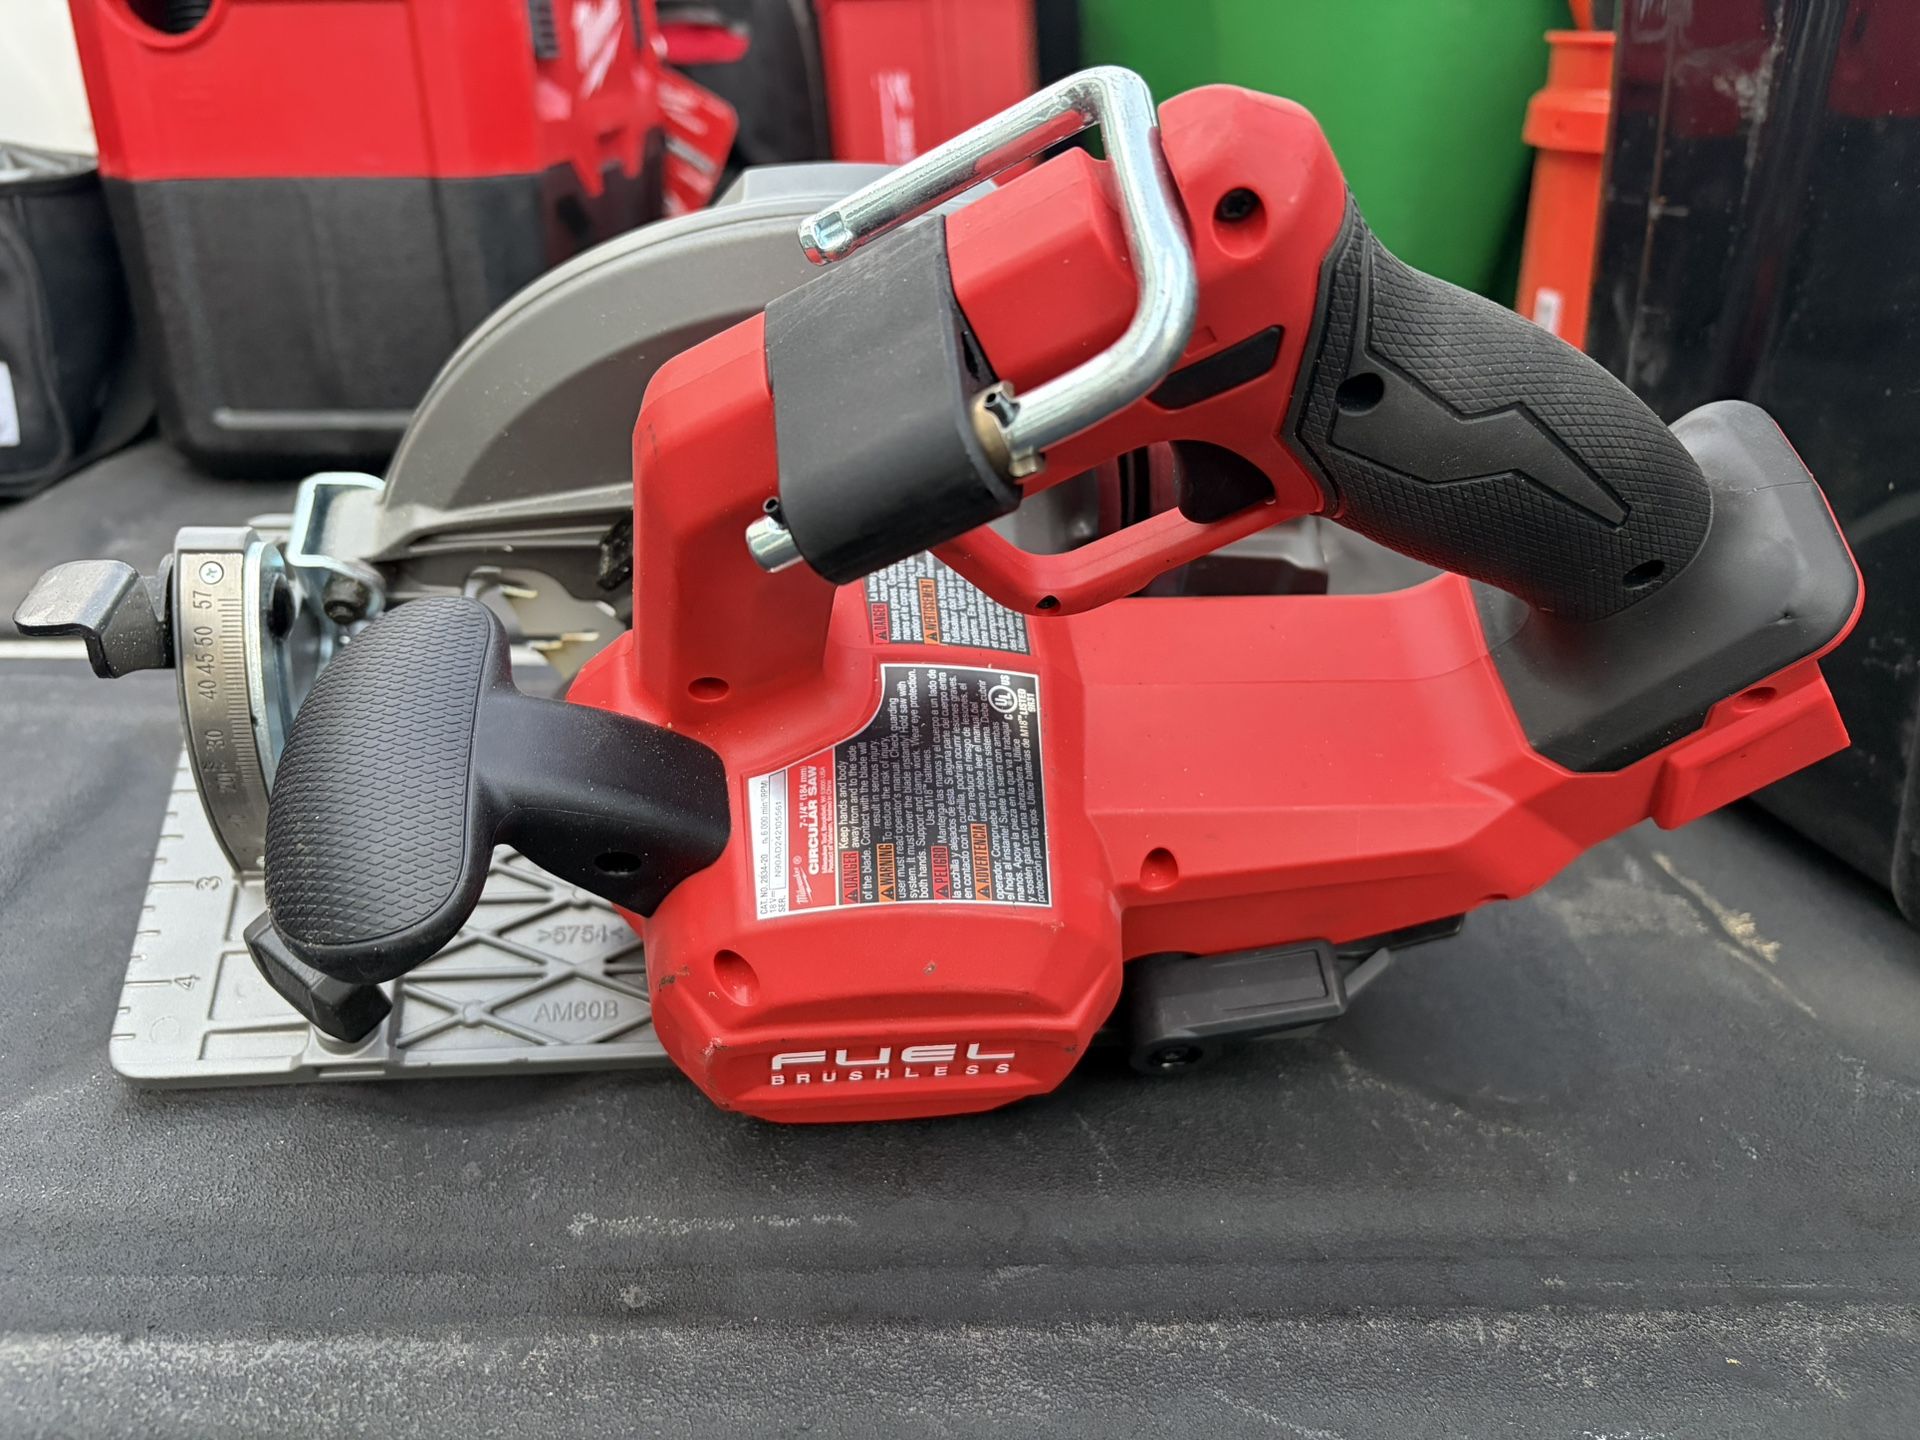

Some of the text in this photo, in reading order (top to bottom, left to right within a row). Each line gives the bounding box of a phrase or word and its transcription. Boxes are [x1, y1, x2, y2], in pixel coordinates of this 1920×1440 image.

[192, 590, 213, 610] 57
[921, 580, 936, 631] AVERTISSEMENT
[873, 605, 886, 630] DANGER
[193, 625, 214, 647] 50
[194, 653, 216, 675] 45
[197, 679, 219, 700] 40
[897, 681, 906, 696] with
[949, 676, 960, 702] graves.
[978, 680, 988, 701] cubrir
[900, 698, 908, 714] saw
[980, 703, 989, 723] Debe
[1017, 688, 1029, 715] LISTED
[888, 698, 900, 730] guarding
[899, 715, 908, 733] Hold
[951, 703, 960, 733] lesiones
[889, 733, 899, 757] Check
[992, 721, 1001, 747] ambas
[963, 738, 974, 762] riesgo
[974, 754, 983, 768] leer
[995, 748, 1003, 763] con
[869, 739, 881, 826] result serious injury.
[881, 771, 889, 785] risk
[902, 772, 912, 793] blade
[908, 669, 929, 898] both hands. Support and clamp Wear eye protection.
[928, 680, 948, 883] PELIGRO Mantenga las manos cuerpo lado
[939, 672, 961, 889] cuchilla alejados Si alguna parte del cuerpo entra
[964, 774, 976, 800] reducir
[976, 771, 985, 790] debe
[995, 764, 1005, 787] sierra
[848, 745, 861, 848] away from and the side
[881, 786, 890, 799] the
[903, 796, 912, 808] the
[858, 742, 871, 889] the blade. Contact with the blade will
[881, 802, 891, 829] reduce
[893, 793, 905, 834] operator's
[925, 809, 935, 826] Use
[967, 803, 977, 821] Para
[978, 793, 987, 821] usuario
[998, 798, 1009, 823] Sujete
[1002, 721, 1025, 901] manos. Apoye pieza que trabajar
[1013, 739, 1035, 894] sostén con una abrazadera. Utilice
[807, 766, 819, 875] CIRCULAR SAW
[837, 760, 858, 888] DANGER Keep hands and body
[882, 832, 892, 841] To
[895, 836, 904, 854] read
[906, 834, 915, 855] must
[961, 834, 969, 849] con
[989, 810, 1001, 857] Compruebe
[1025, 782, 1046, 902] protección para los Utilice
[879, 845, 893, 885] WARNING
[896, 856, 905, 877] must
[972, 826, 989, 883] ADVERTENCIA
[760, 854, 768, 883] 2834-20
[961, 851, 971, 885] contacto
[992, 859, 1005, 899] operador.
[195, 876, 223, 890] 3
[897, 880, 906, 898] user
[908, 865, 919, 898] system.
[1004, 873, 1015, 890] hoja
[760, 899, 768, 914] CAT.
[778, 895, 786, 912] SER.
[173, 973, 201, 990] 4
[533, 1000, 620, 1024] AM60B
[770, 1042, 1016, 1071] FUEL
[770, 1062, 1010, 1087] BRUSHLESS
